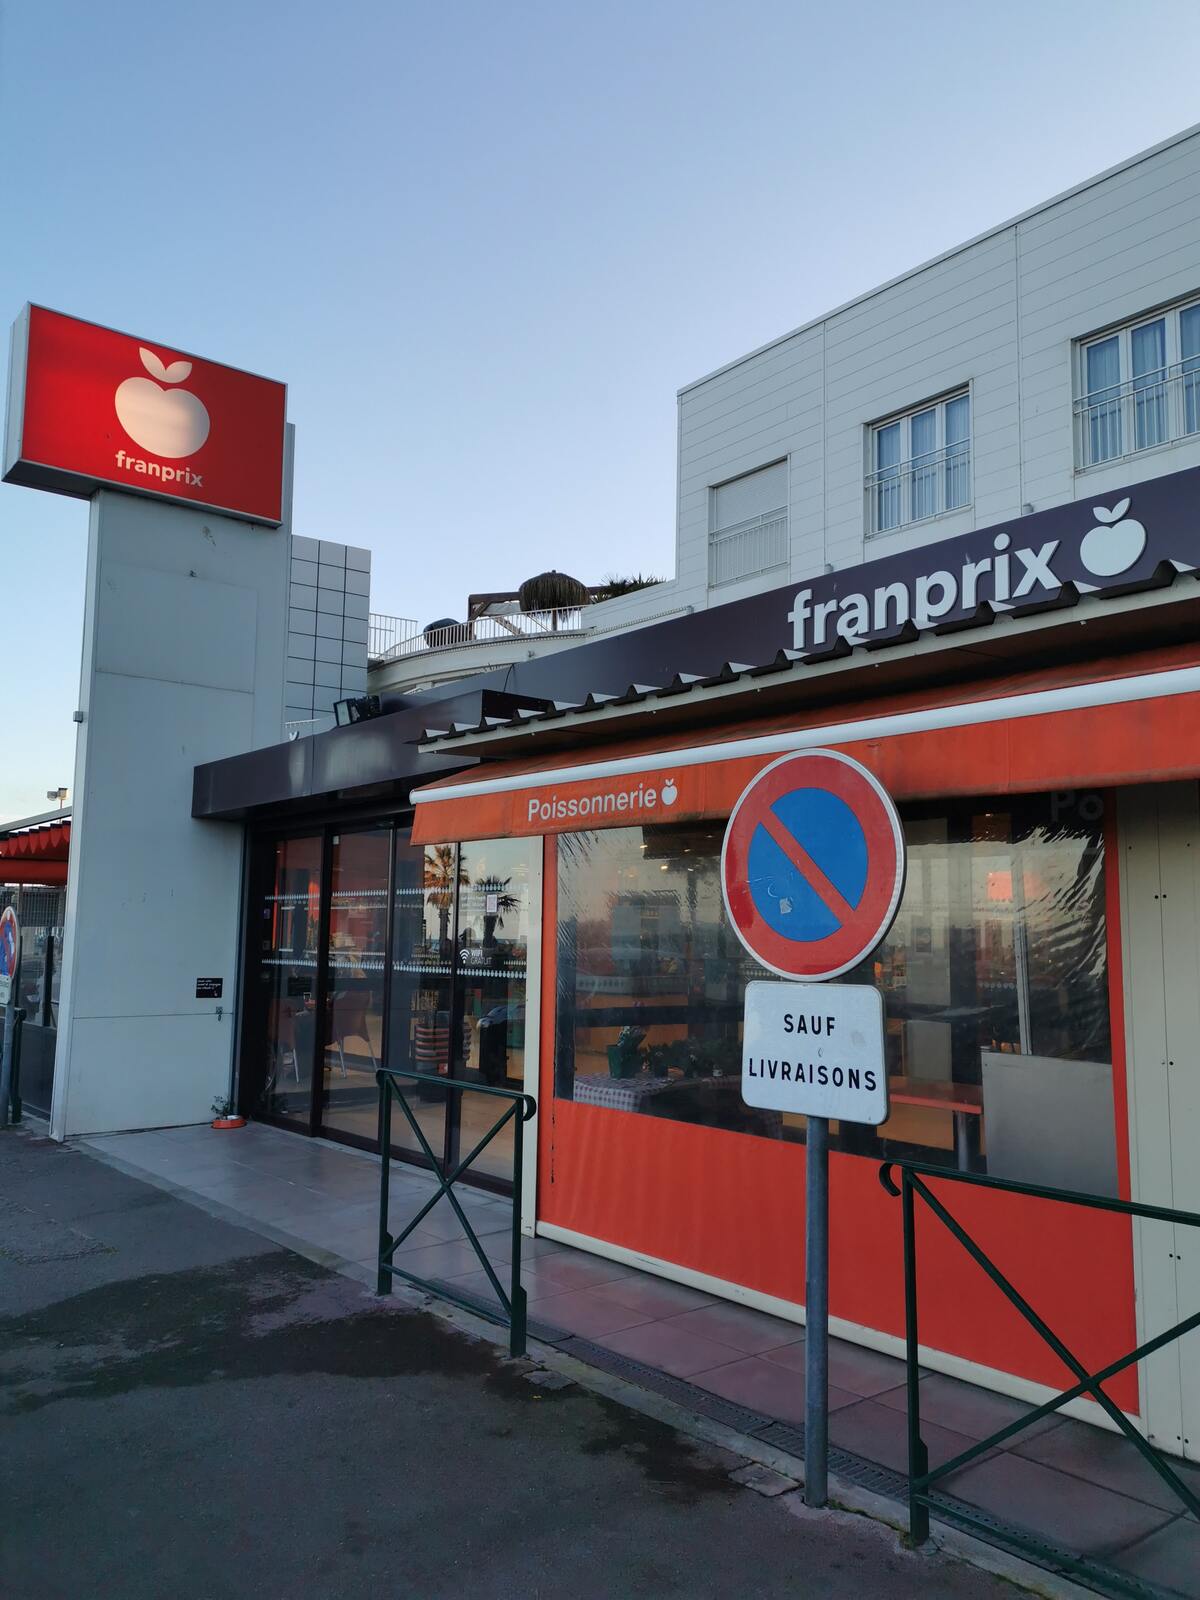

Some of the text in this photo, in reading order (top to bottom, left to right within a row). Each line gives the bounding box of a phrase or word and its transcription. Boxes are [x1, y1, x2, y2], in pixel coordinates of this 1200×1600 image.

[115, 450, 203, 487] franprix
[787, 533, 1063, 647] franprix
[528, 784, 657, 822] Poissonnerie
[784, 1013, 836, 1036] SAUF
[749, 1058, 877, 1091] LIVRAISONS
